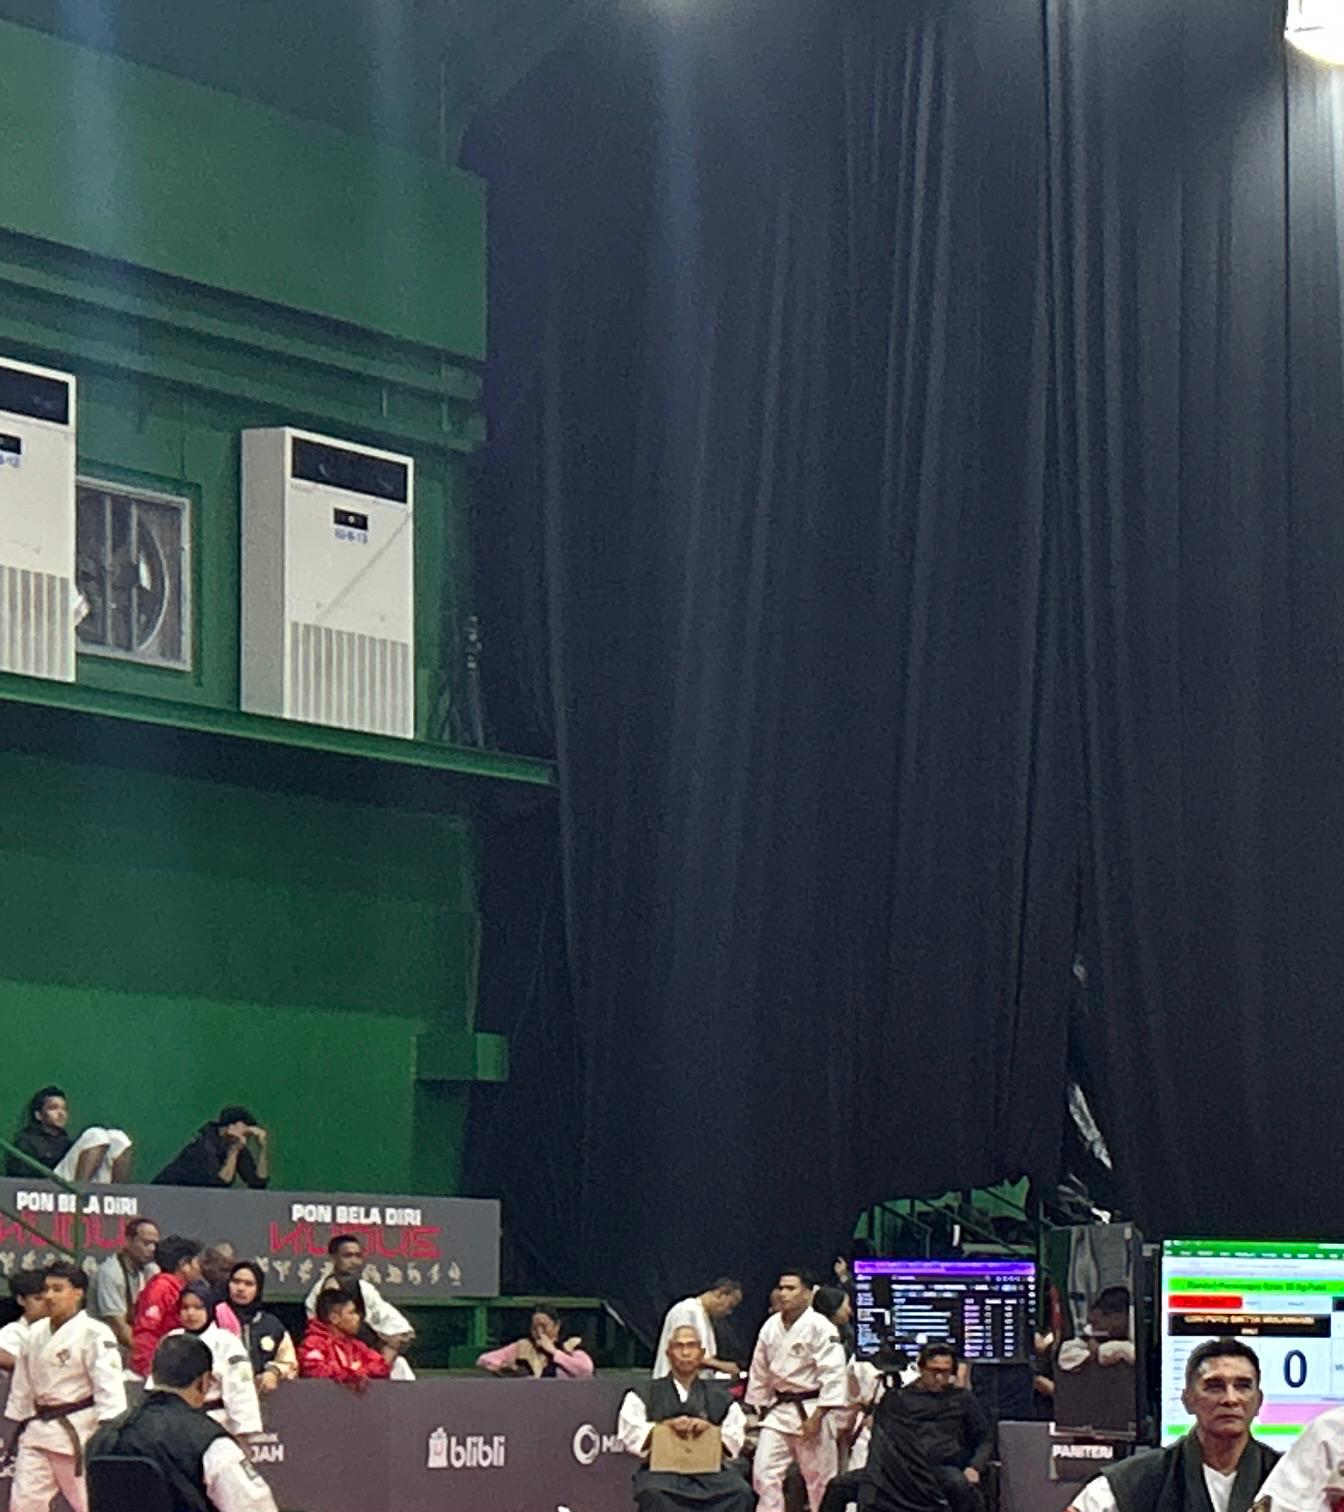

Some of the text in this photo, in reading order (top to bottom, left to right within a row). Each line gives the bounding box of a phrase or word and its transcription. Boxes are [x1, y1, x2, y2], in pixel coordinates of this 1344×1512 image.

[16, 1191, 54, 1212] PON
[103, 1195, 138, 1216] DIRI
[291, 1203, 422, 1226] PON BELA DIRI
[1283, 1349, 1308, 1389] 0
[450, 1435, 506, 1469] blibli
